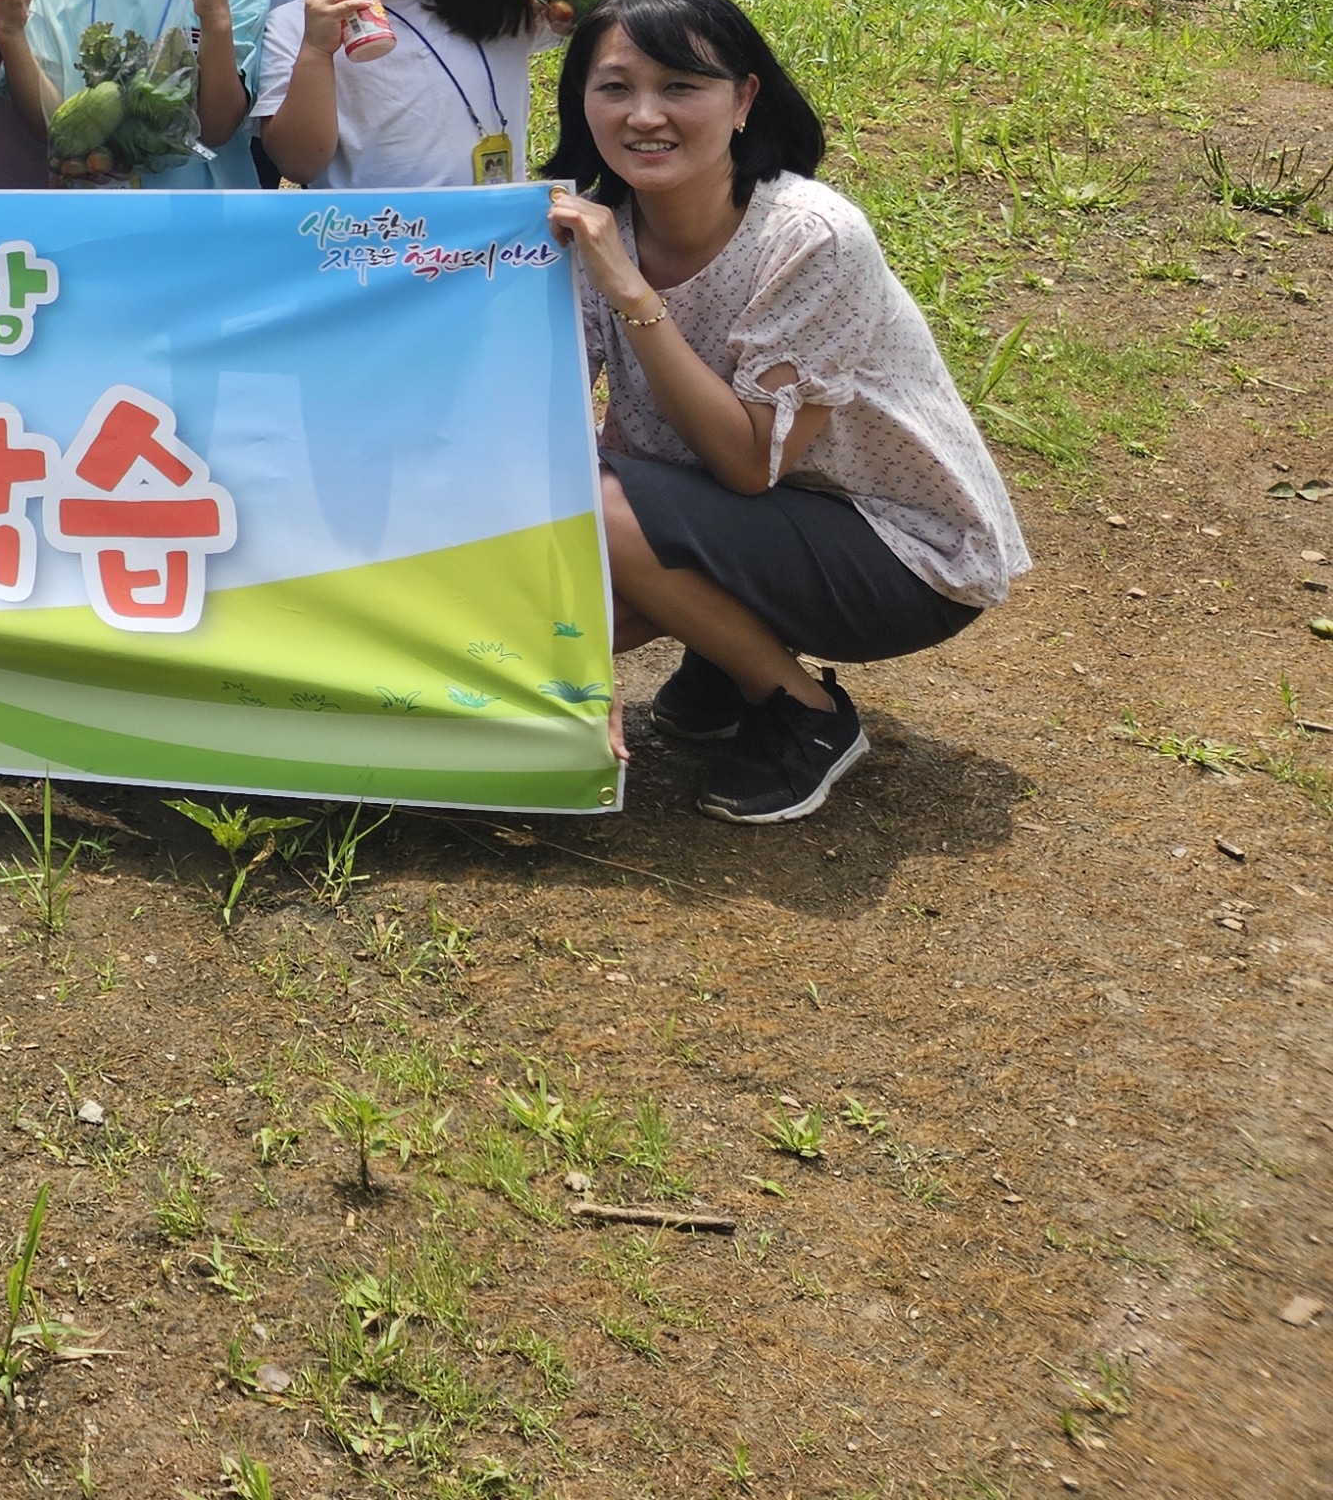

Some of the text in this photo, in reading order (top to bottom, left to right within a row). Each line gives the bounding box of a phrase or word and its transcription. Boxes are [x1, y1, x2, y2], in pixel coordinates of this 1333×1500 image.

[300, 207, 370, 248] 시민과
[320, 242, 561, 285] 자유로운 혁신도시 안산
